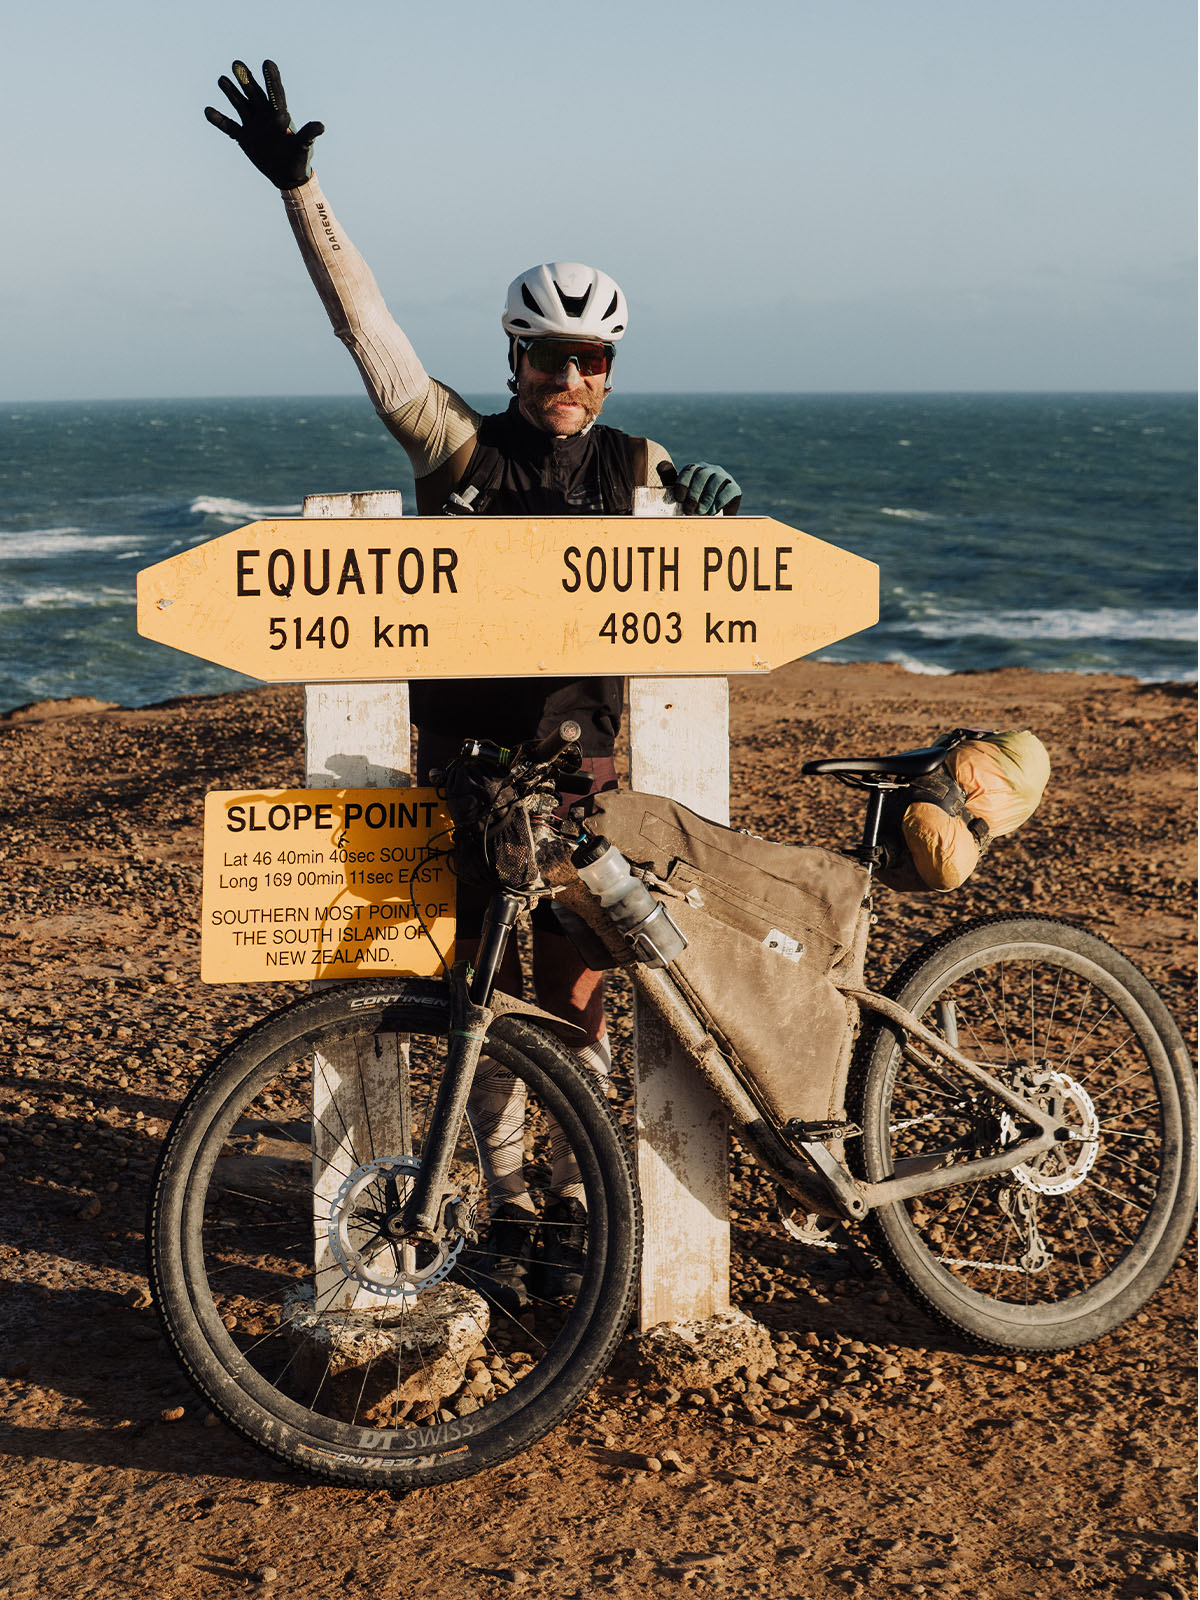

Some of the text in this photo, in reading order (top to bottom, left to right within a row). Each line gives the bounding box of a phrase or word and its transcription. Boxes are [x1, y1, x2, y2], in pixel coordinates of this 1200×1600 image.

[316, 202, 341, 251] DAREVIE
[236, 547, 458, 598] EQUATOR
[561, 545, 793, 592] SOUTH POLE
[269, 616, 429, 650] 5140 km
[598, 611, 683, 644] 4803
[705, 612, 757, 643] km
[226, 802, 438, 832] SLOPE POINT
[223, 847, 440, 867] Lat 46 40min 40sec SOUTH
[219, 868, 443, 891] Long 169 00min 11sec EAST
[211, 903, 449, 926] SOUTHERN MOST POINT OF
[232, 925, 428, 946] THE SOUTH ISLAND OF
[266, 948, 394, 967] NEW ZEALAND.
[350, 994, 448, 1008] CONTINEN
[358, 1418, 475, 1449] DT SWISS
